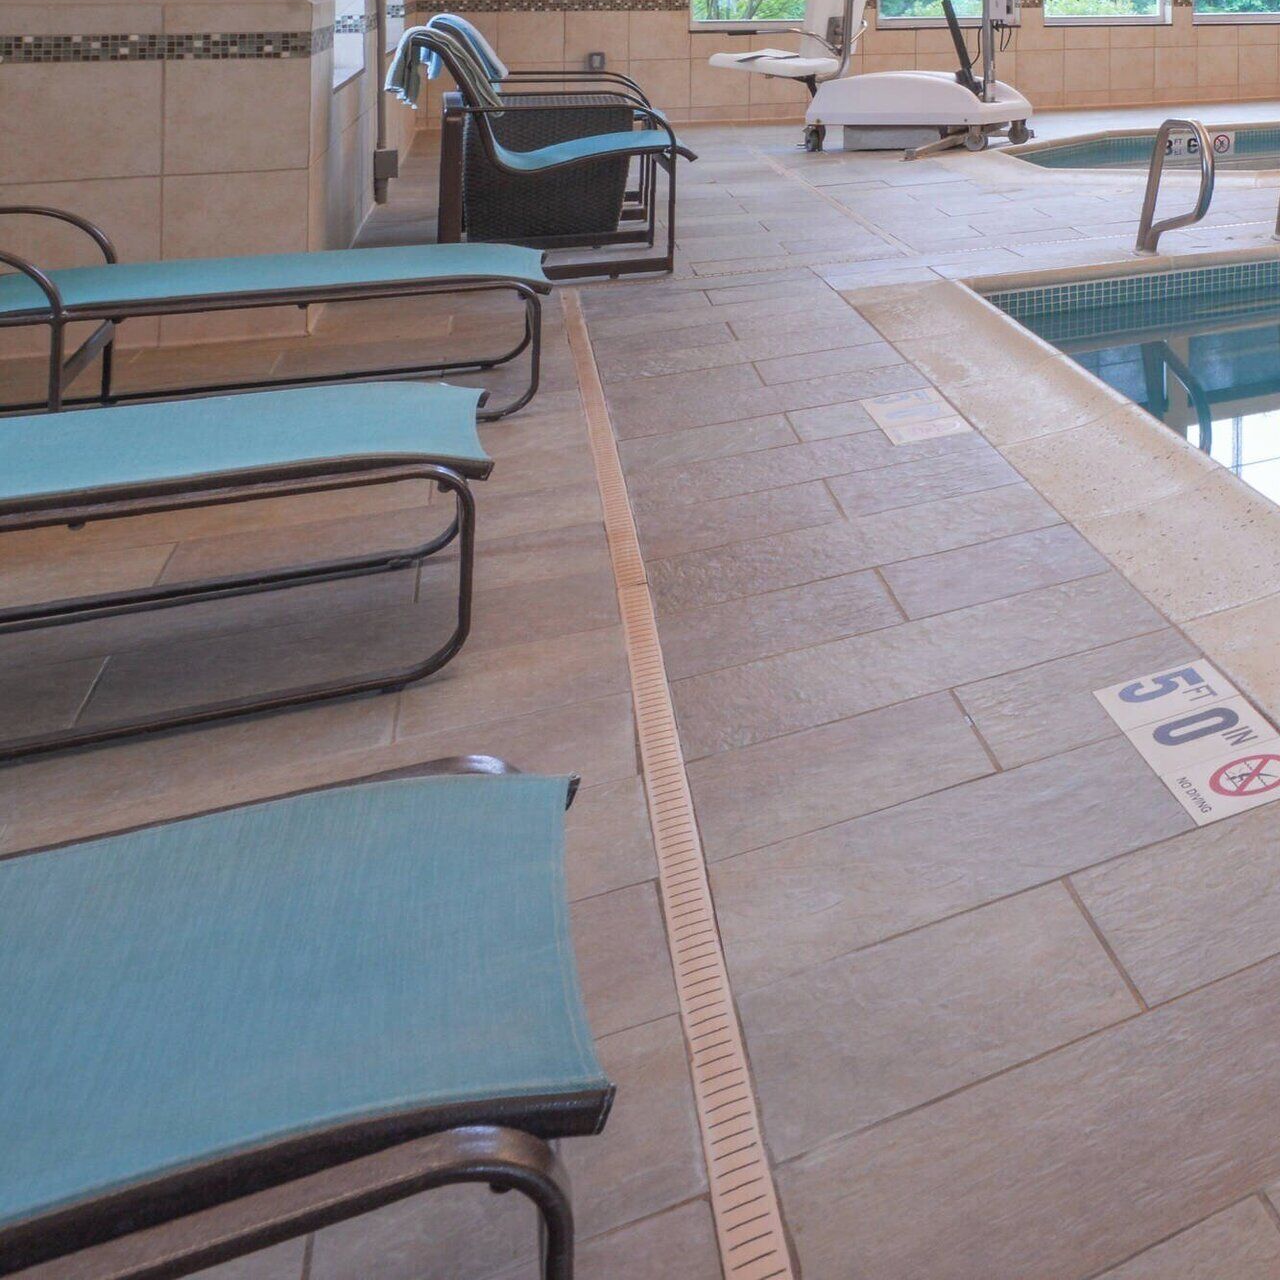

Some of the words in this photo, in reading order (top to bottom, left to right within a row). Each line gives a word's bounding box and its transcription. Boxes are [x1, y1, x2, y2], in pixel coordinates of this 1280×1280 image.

[1118, 666, 1205, 703] 5
[1182, 684, 1218, 702] FT
[1152, 707, 1240, 746] 0
[1221, 726, 1258, 747] IN
[1176, 776, 1193, 789] NO
[1185, 788, 1212, 813] DIVING
